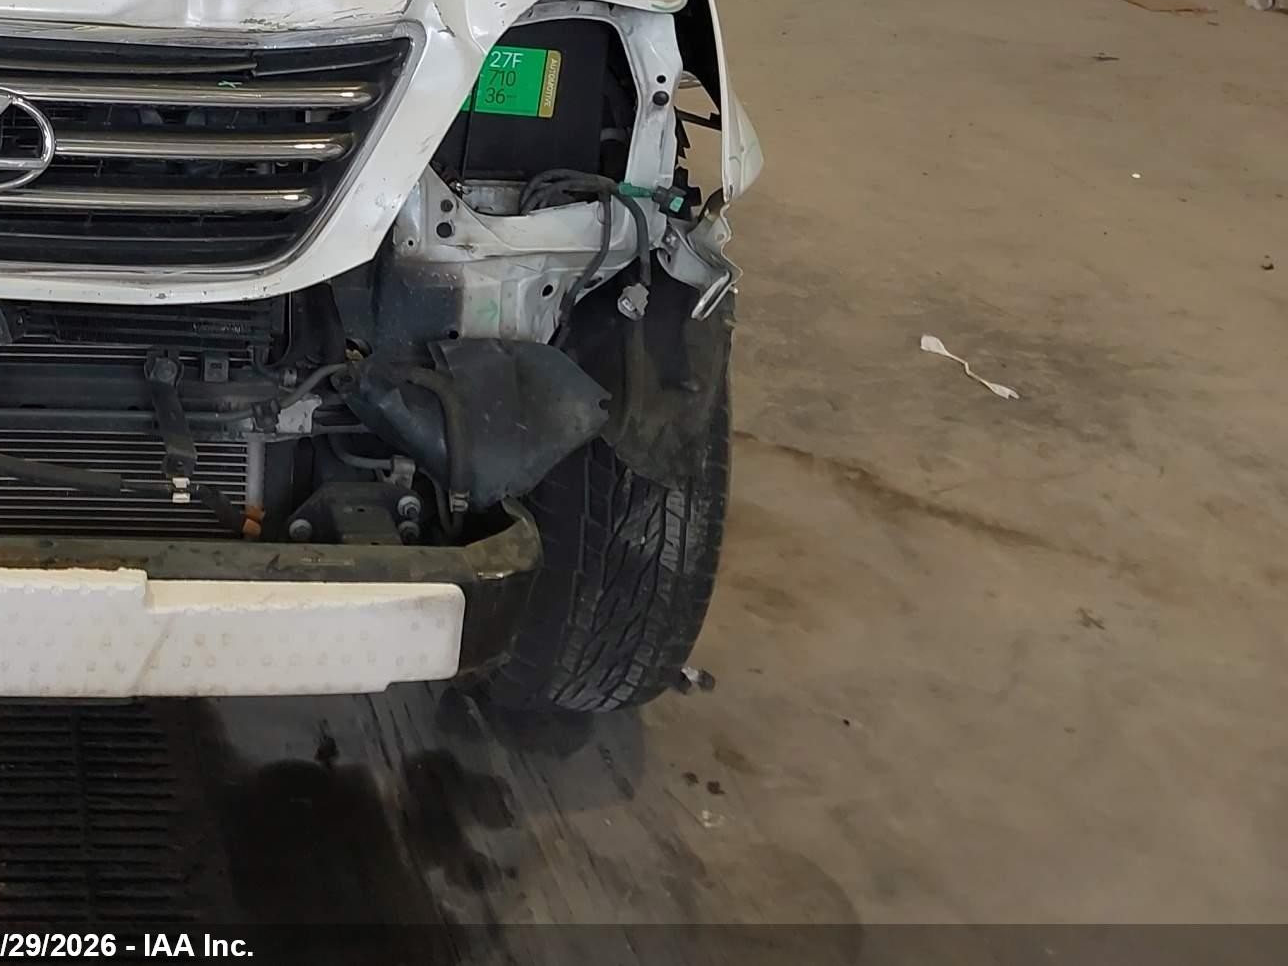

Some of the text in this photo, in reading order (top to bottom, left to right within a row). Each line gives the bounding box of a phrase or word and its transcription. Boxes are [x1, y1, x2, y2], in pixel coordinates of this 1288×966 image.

[490, 51, 524, 68] 27F
[488, 69, 517, 87] 710
[544, 58, 559, 107] AUTOMOTIVE
